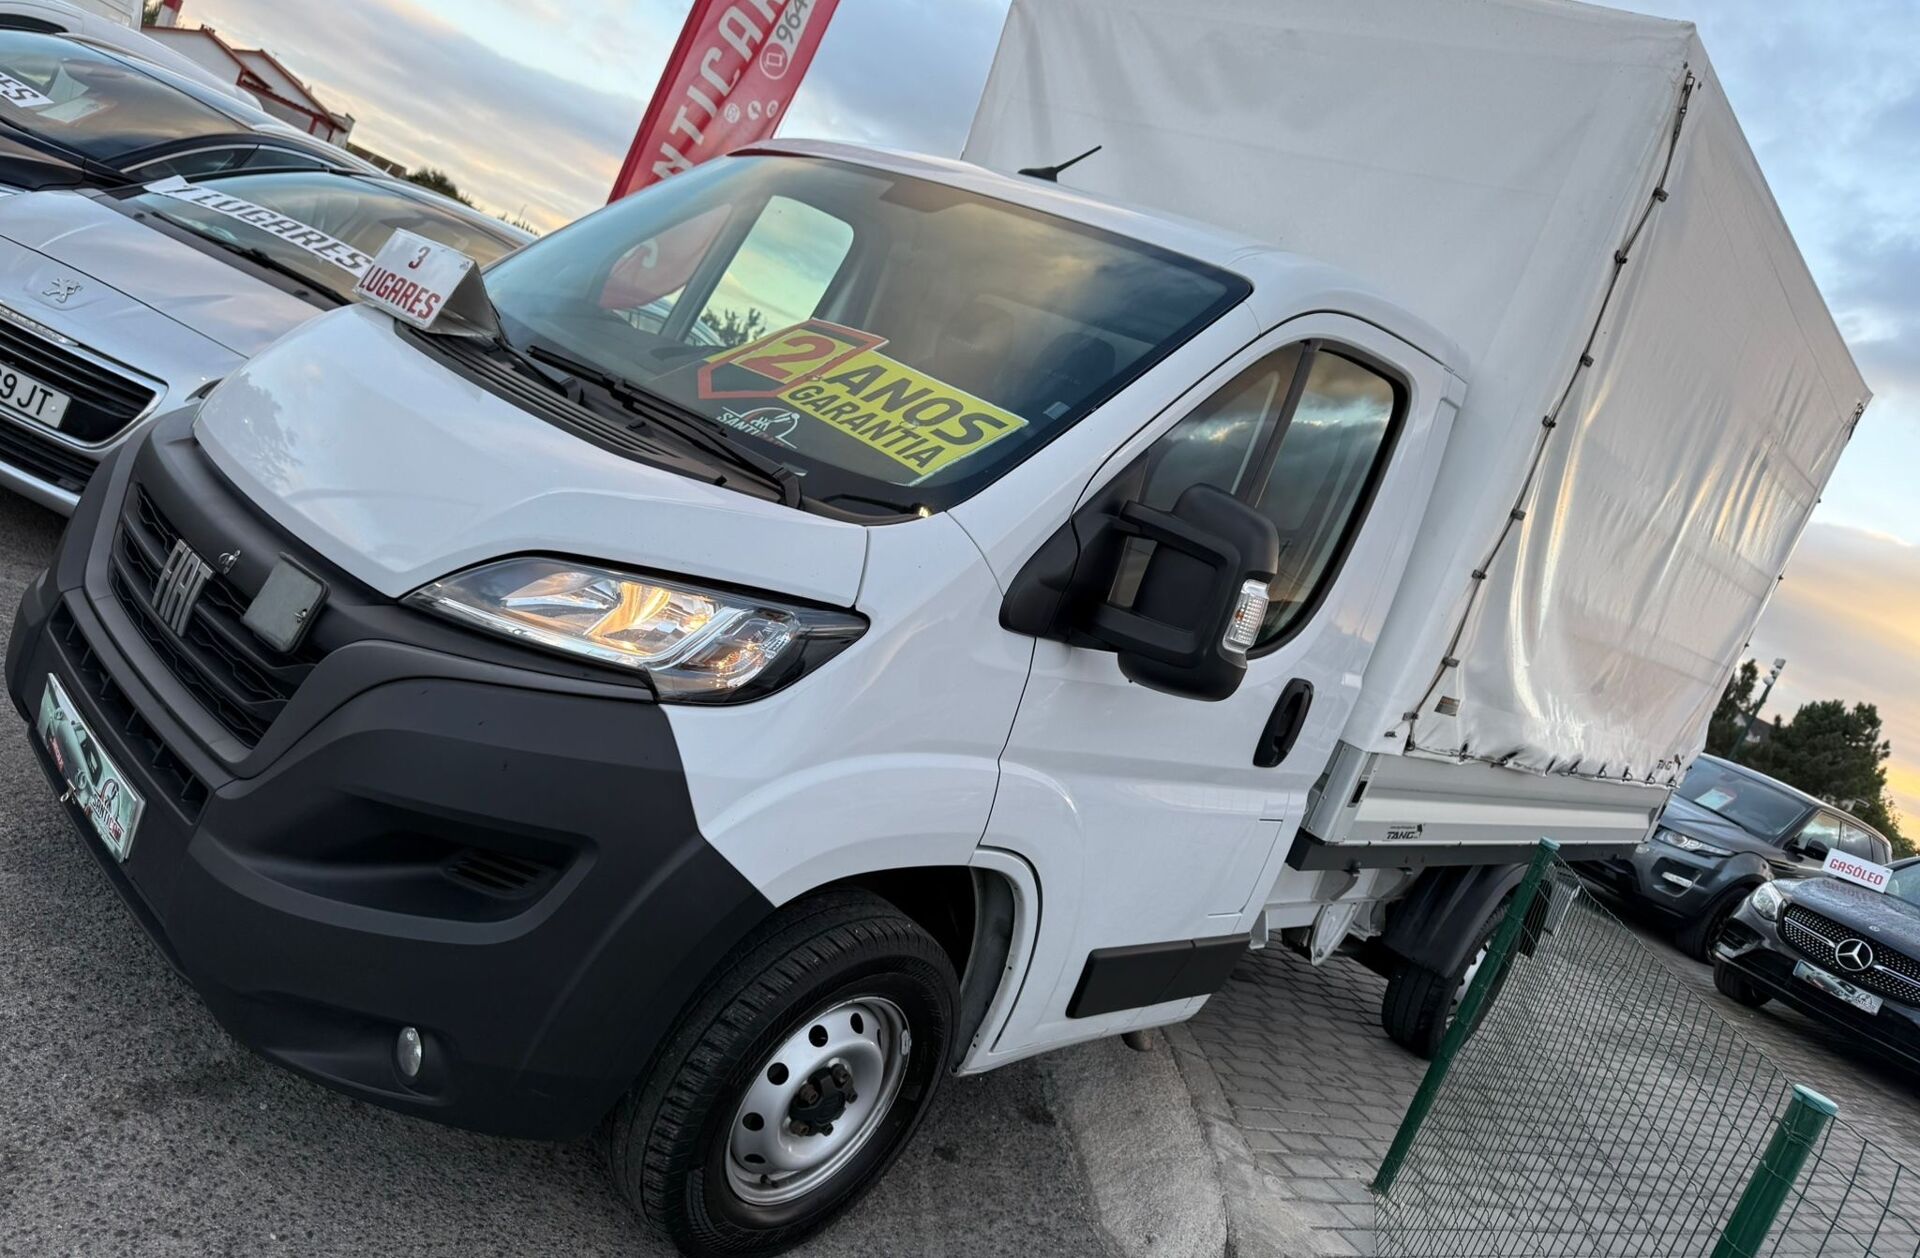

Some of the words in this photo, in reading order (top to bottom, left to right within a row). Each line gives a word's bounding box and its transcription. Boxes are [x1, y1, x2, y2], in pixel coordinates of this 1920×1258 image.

[0, 74, 39, 100] ES
[192, 194, 372, 269] LUGARES
[408, 246, 431, 269] 3
[358, 264, 441, 320] LUGARES
[738, 335, 836, 380] 2
[822, 364, 1009, 447] ANOS
[788, 386, 946, 469] GARANTIA
[152, 538, 214, 637] FIAT
[1829, 858, 1884, 886] GASÓLEO
